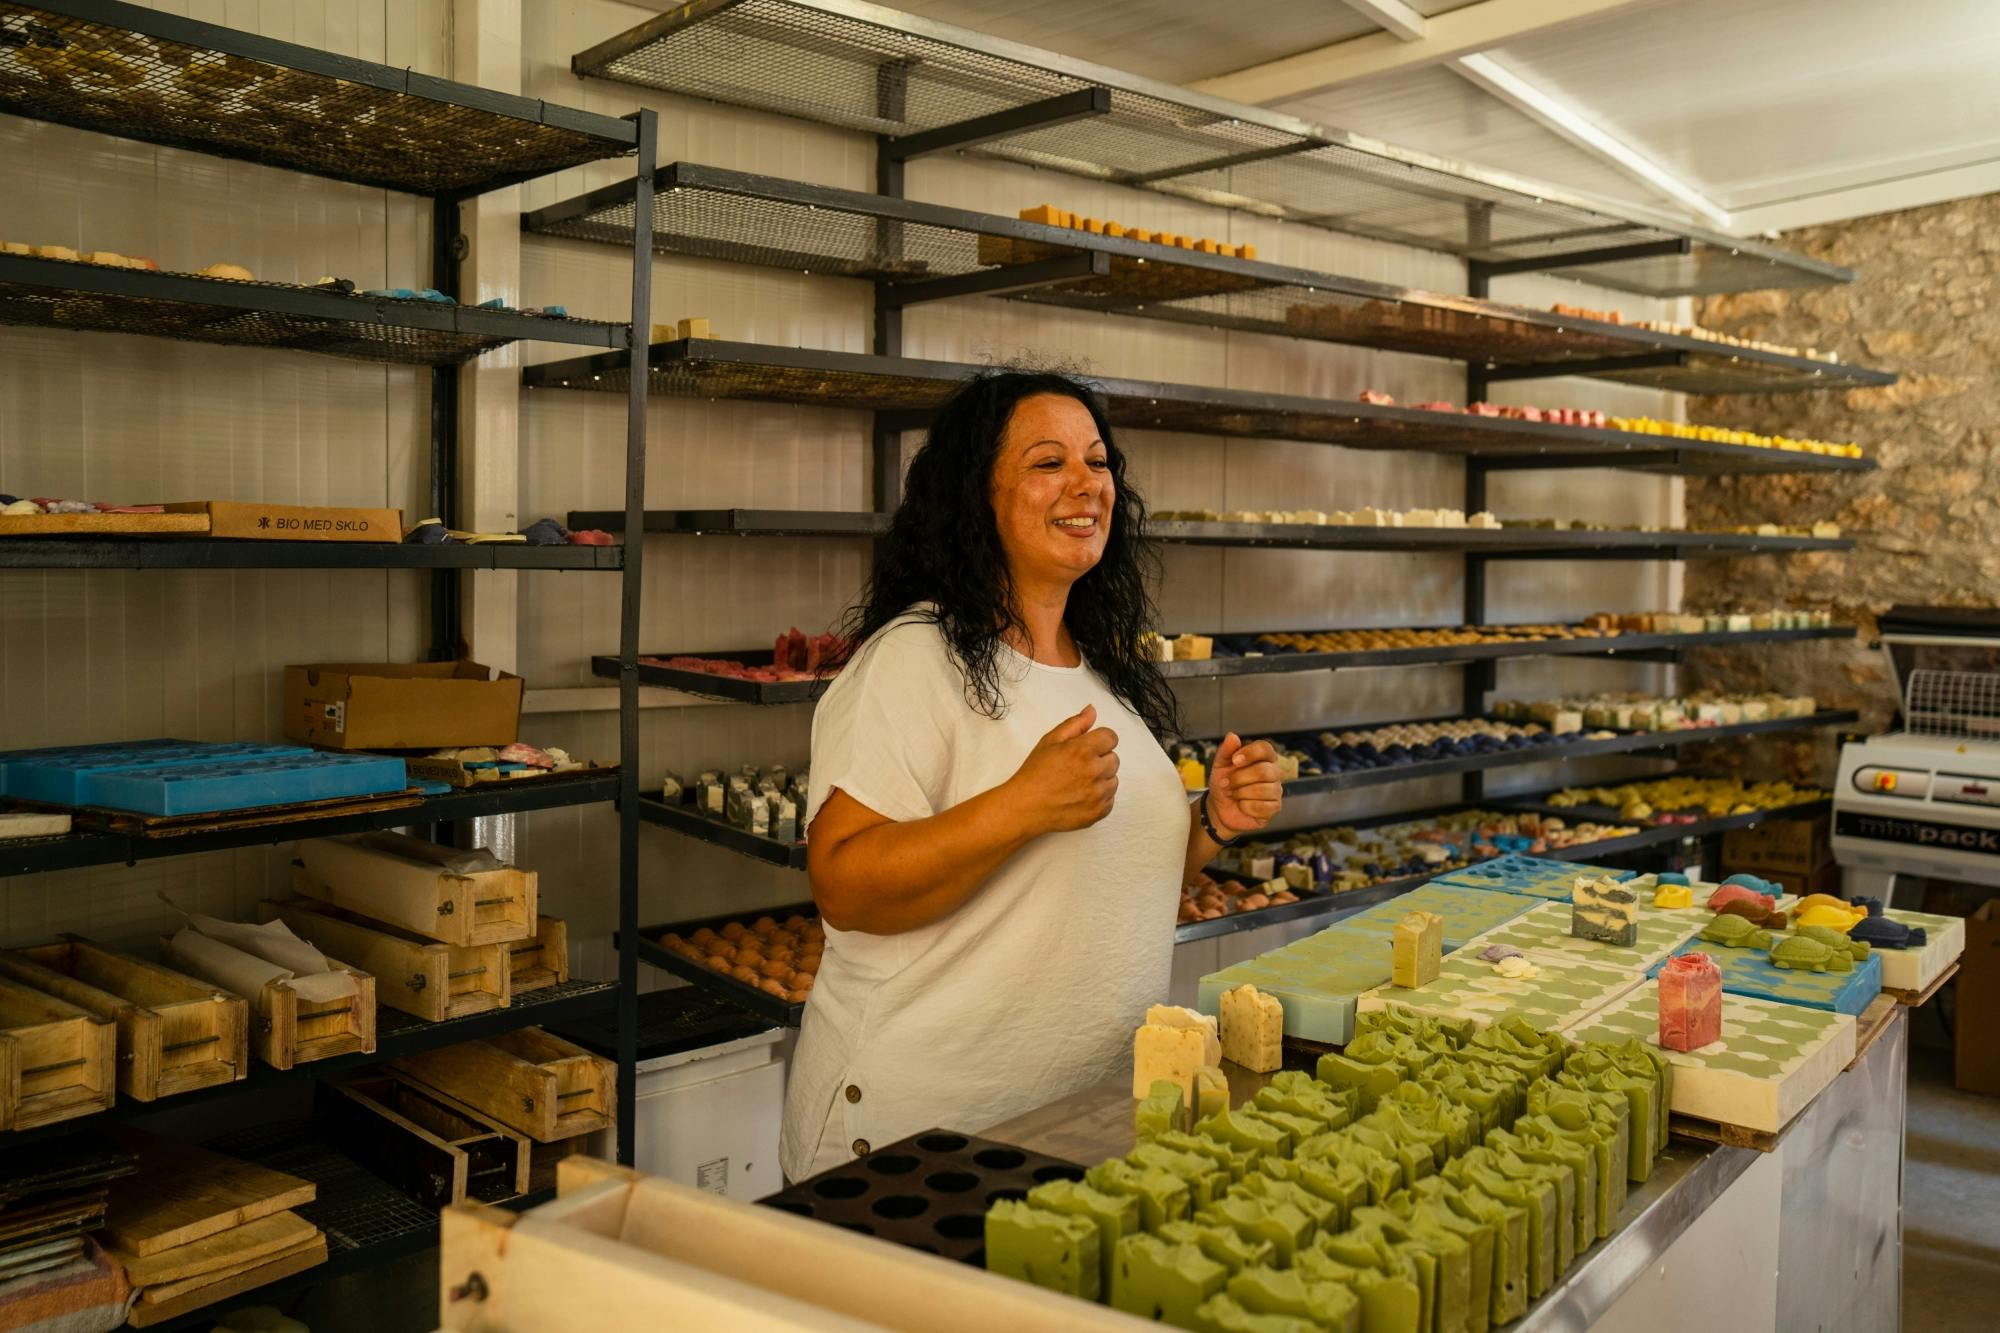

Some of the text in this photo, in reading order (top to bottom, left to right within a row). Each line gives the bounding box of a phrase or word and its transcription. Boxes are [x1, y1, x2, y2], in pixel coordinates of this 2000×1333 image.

[276, 518, 369, 532] BIO MED SKLO
[1857, 816, 2000, 850] minipack
